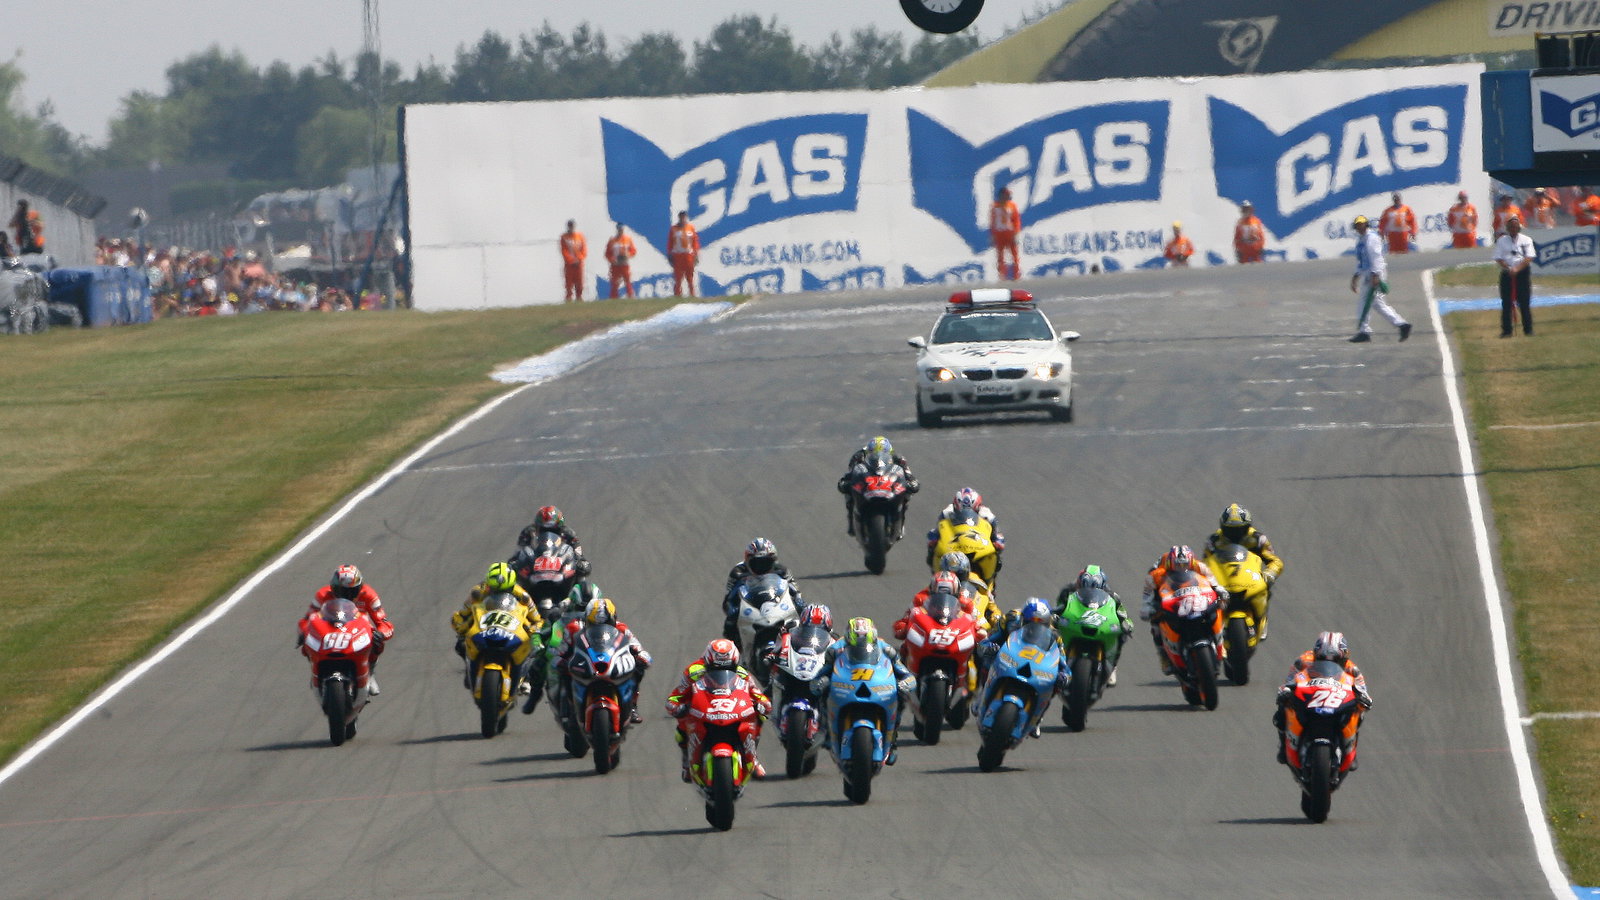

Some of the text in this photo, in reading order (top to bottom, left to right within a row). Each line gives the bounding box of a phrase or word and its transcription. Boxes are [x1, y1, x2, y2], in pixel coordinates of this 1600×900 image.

[1276, 105, 1448, 217] GAS
[671, 133, 848, 232] GAS
[973, 121, 1151, 230] GAS
[928, 627, 960, 646] 65
[1018, 646, 1045, 664] 21
[707, 698, 738, 712] 33
[1307, 690, 1347, 708] 26
